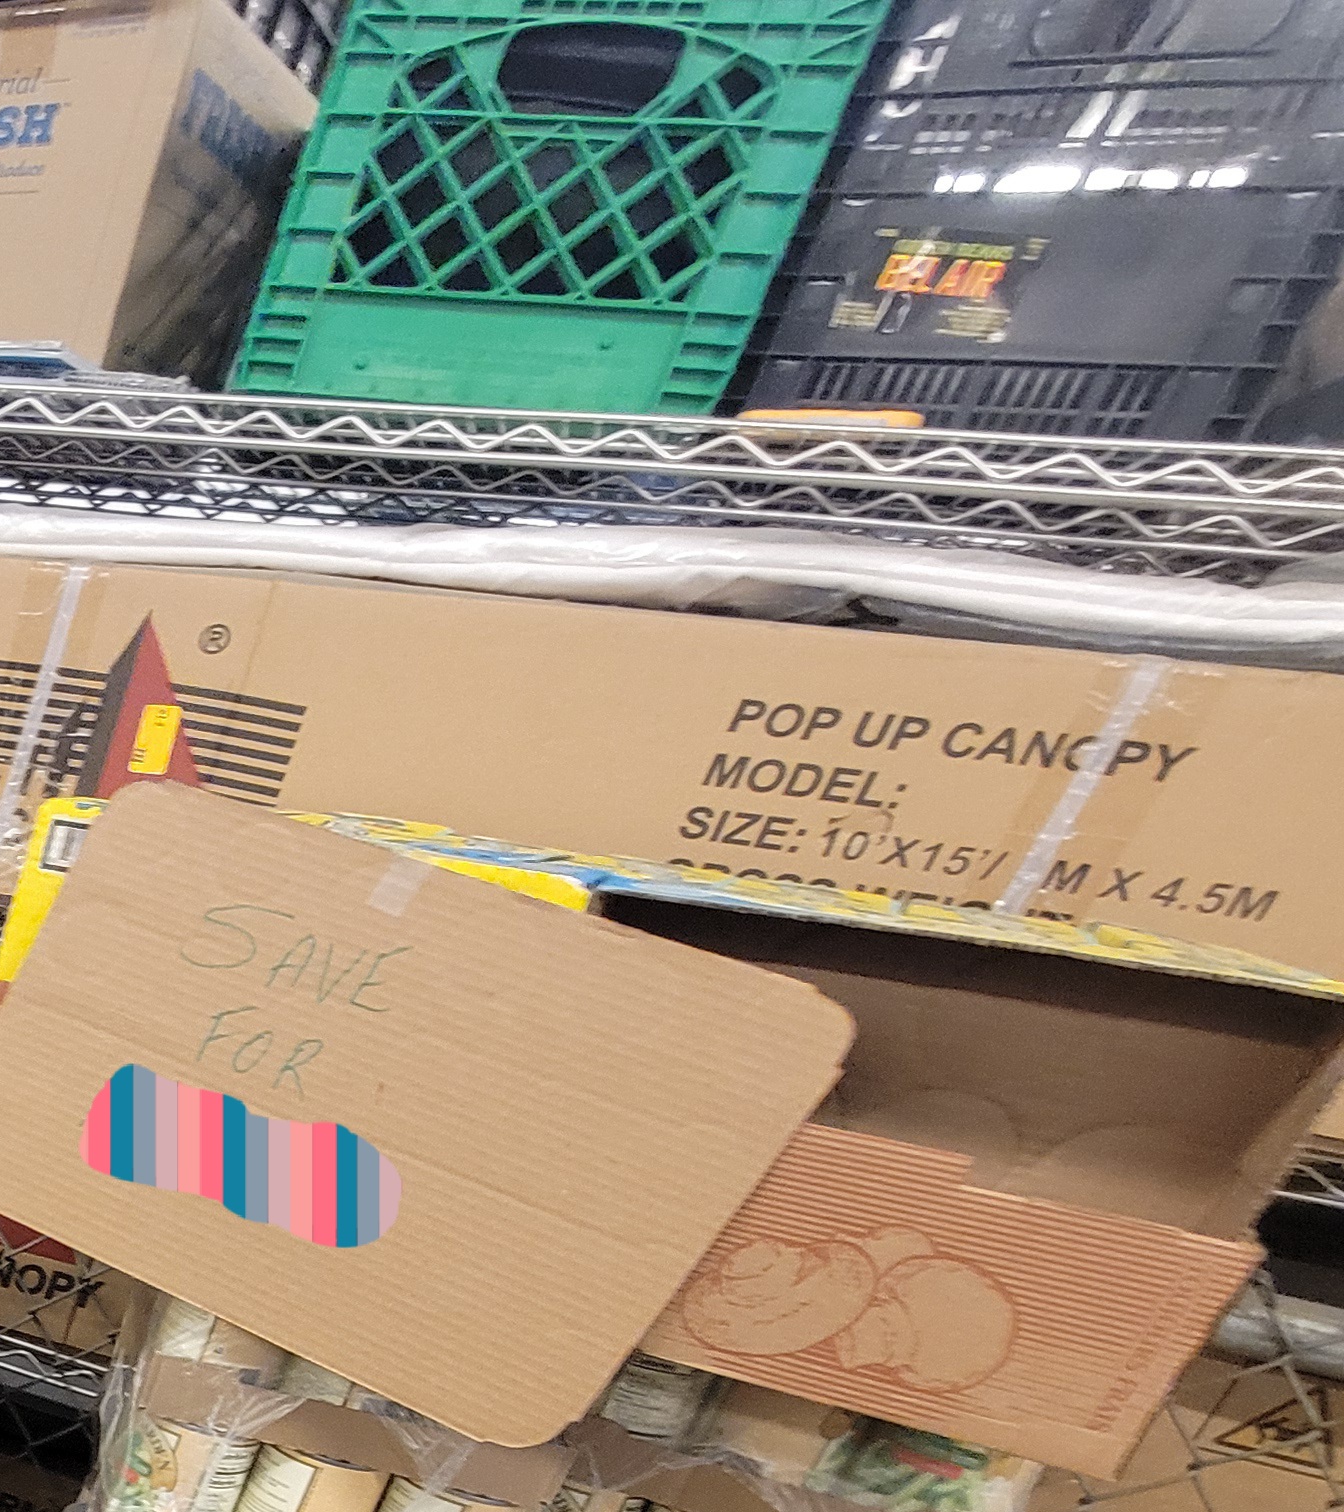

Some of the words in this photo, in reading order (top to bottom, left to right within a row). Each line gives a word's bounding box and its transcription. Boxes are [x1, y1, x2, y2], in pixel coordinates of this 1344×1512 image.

[727, 699, 843, 741] POP
[853, 712, 931, 751] UP
[702, 752, 908, 811] MODEL:
[678, 805, 807, 855] SIZE:
[1099, 868, 1144, 903] X
[1151, 876, 1281, 922] 4.5M
[179, 903, 414, 1013] SAVE
[195, 1004, 325, 1102] FOR
